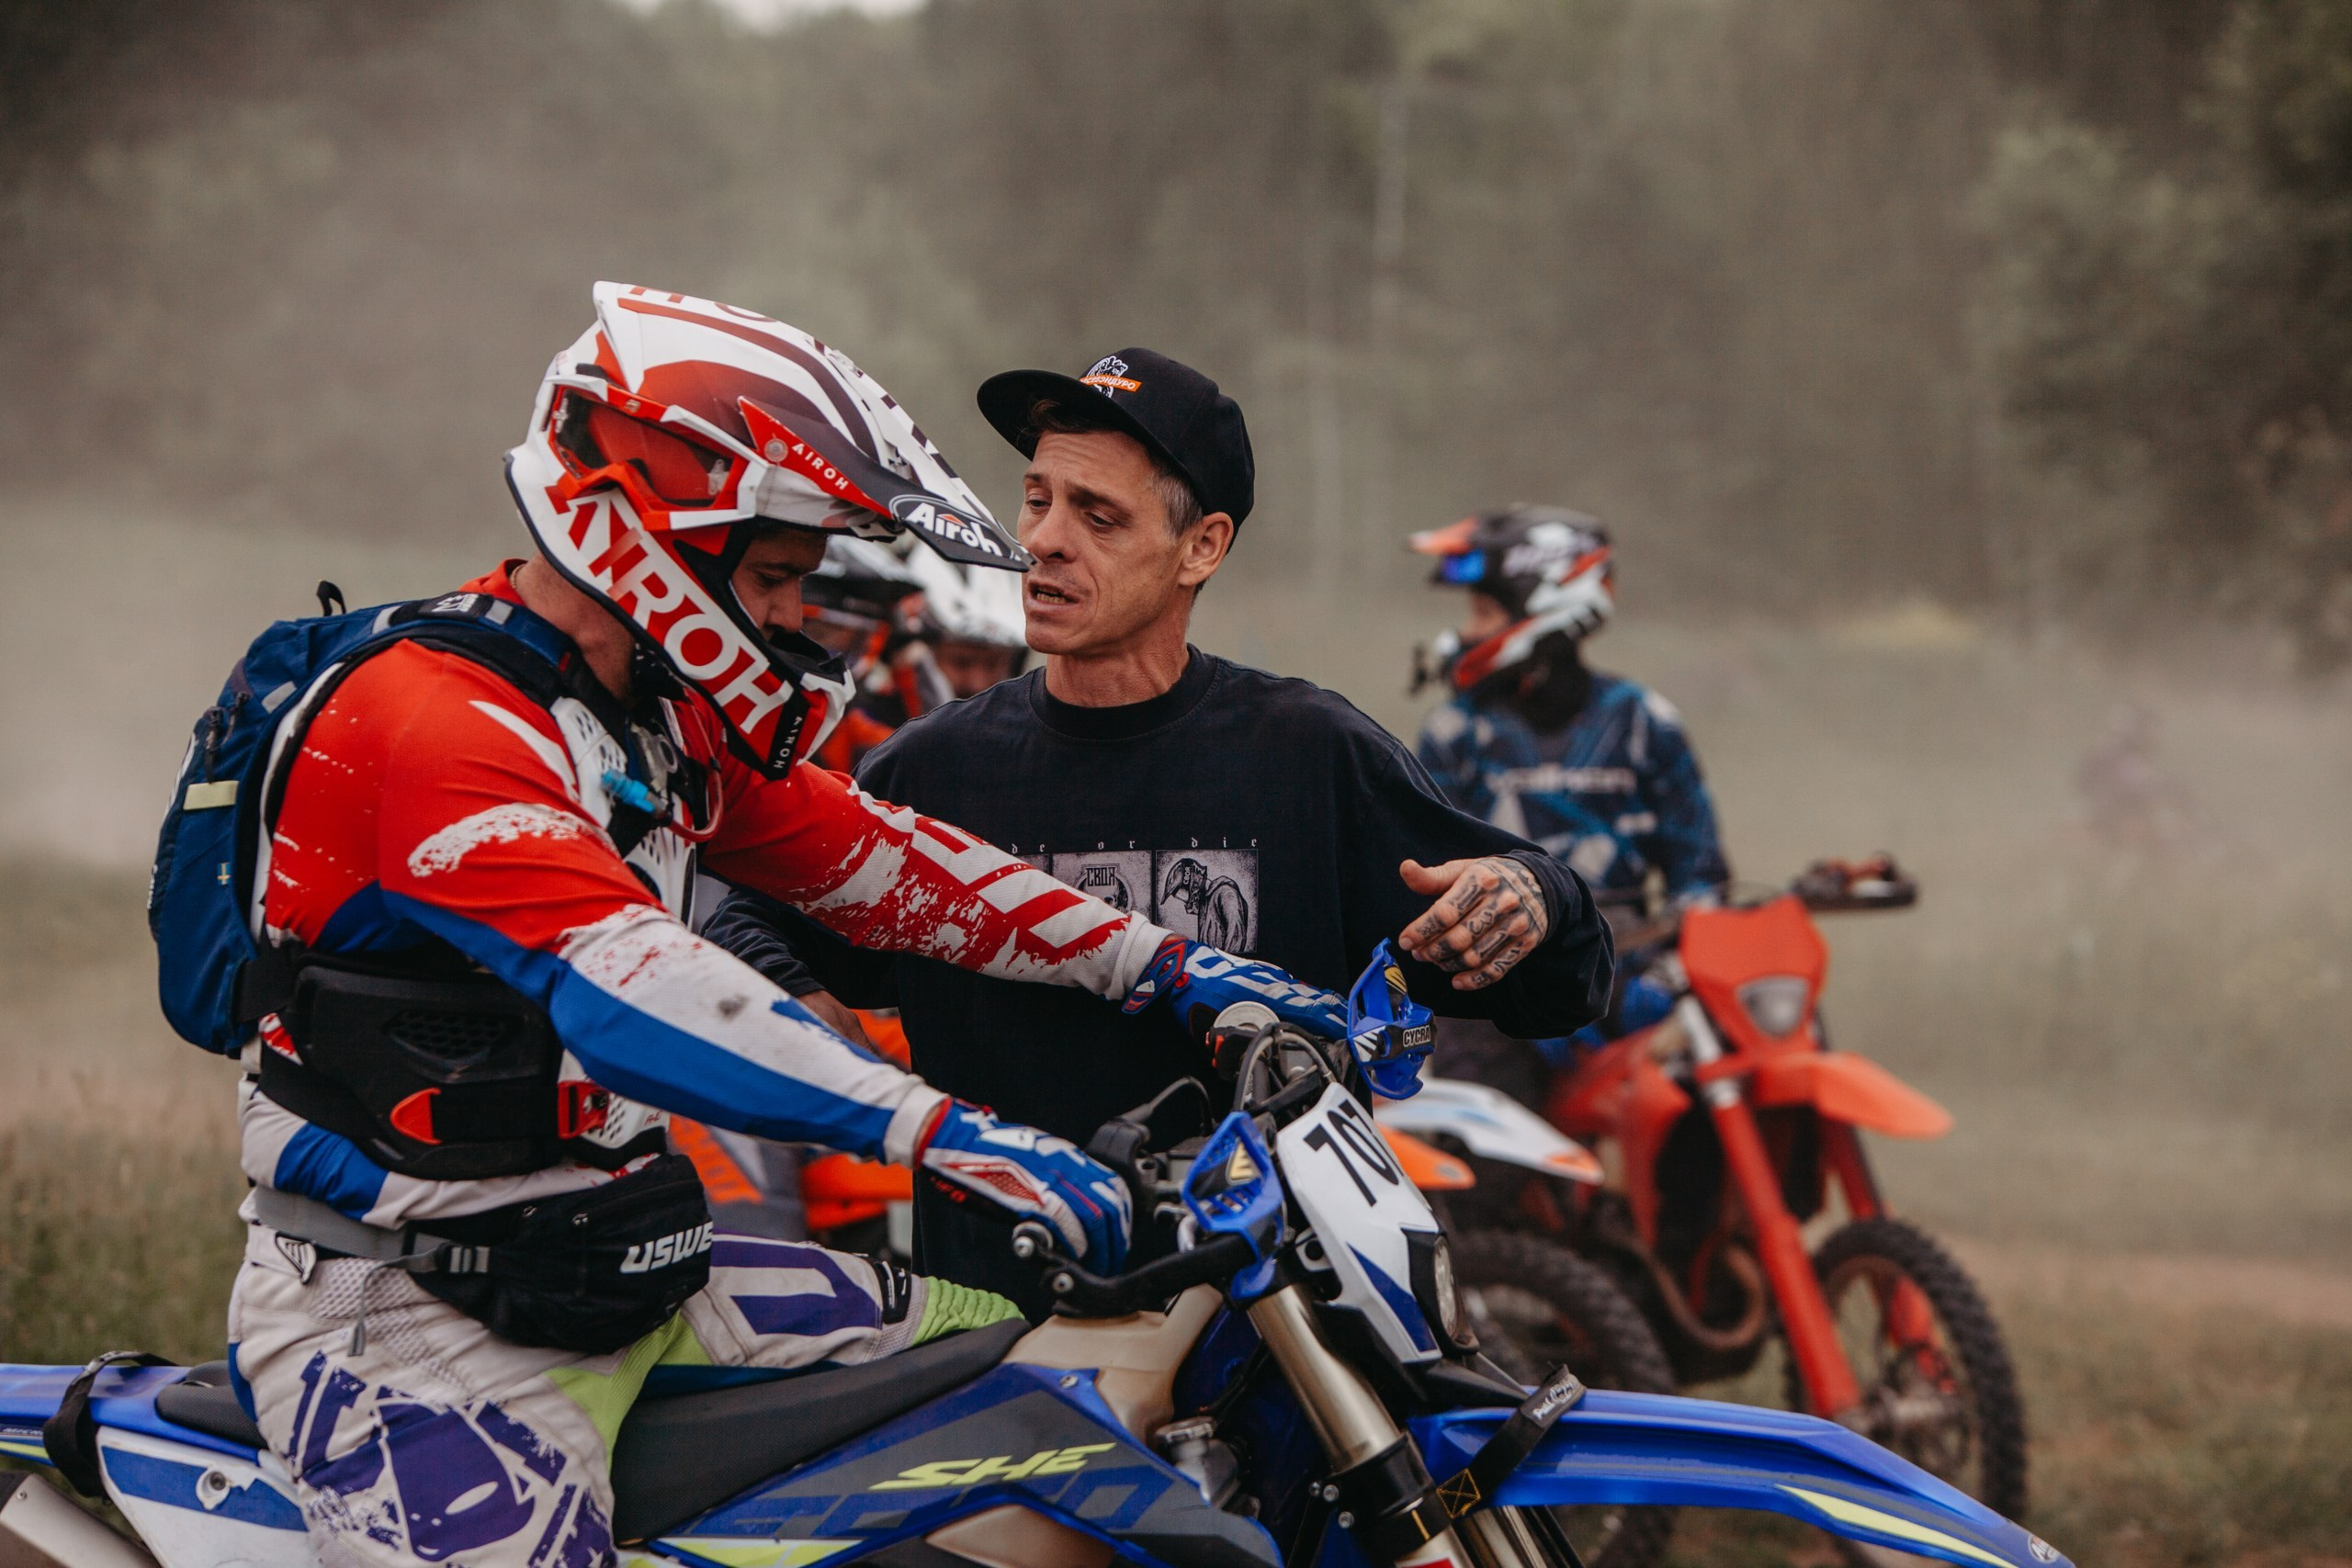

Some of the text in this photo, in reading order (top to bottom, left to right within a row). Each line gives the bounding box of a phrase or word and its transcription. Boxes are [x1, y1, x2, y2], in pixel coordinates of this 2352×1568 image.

[792, 443, 849, 492] AIROH
[905, 502, 1003, 557] Airoh
[548, 484, 794, 734] AIROH
[774, 716, 803, 769] AIROH
[1012, 837, 1258, 854] de or die
[1085, 866, 1116, 886] СВОЯ
[1402, 1024, 1431, 1047] CYCRA
